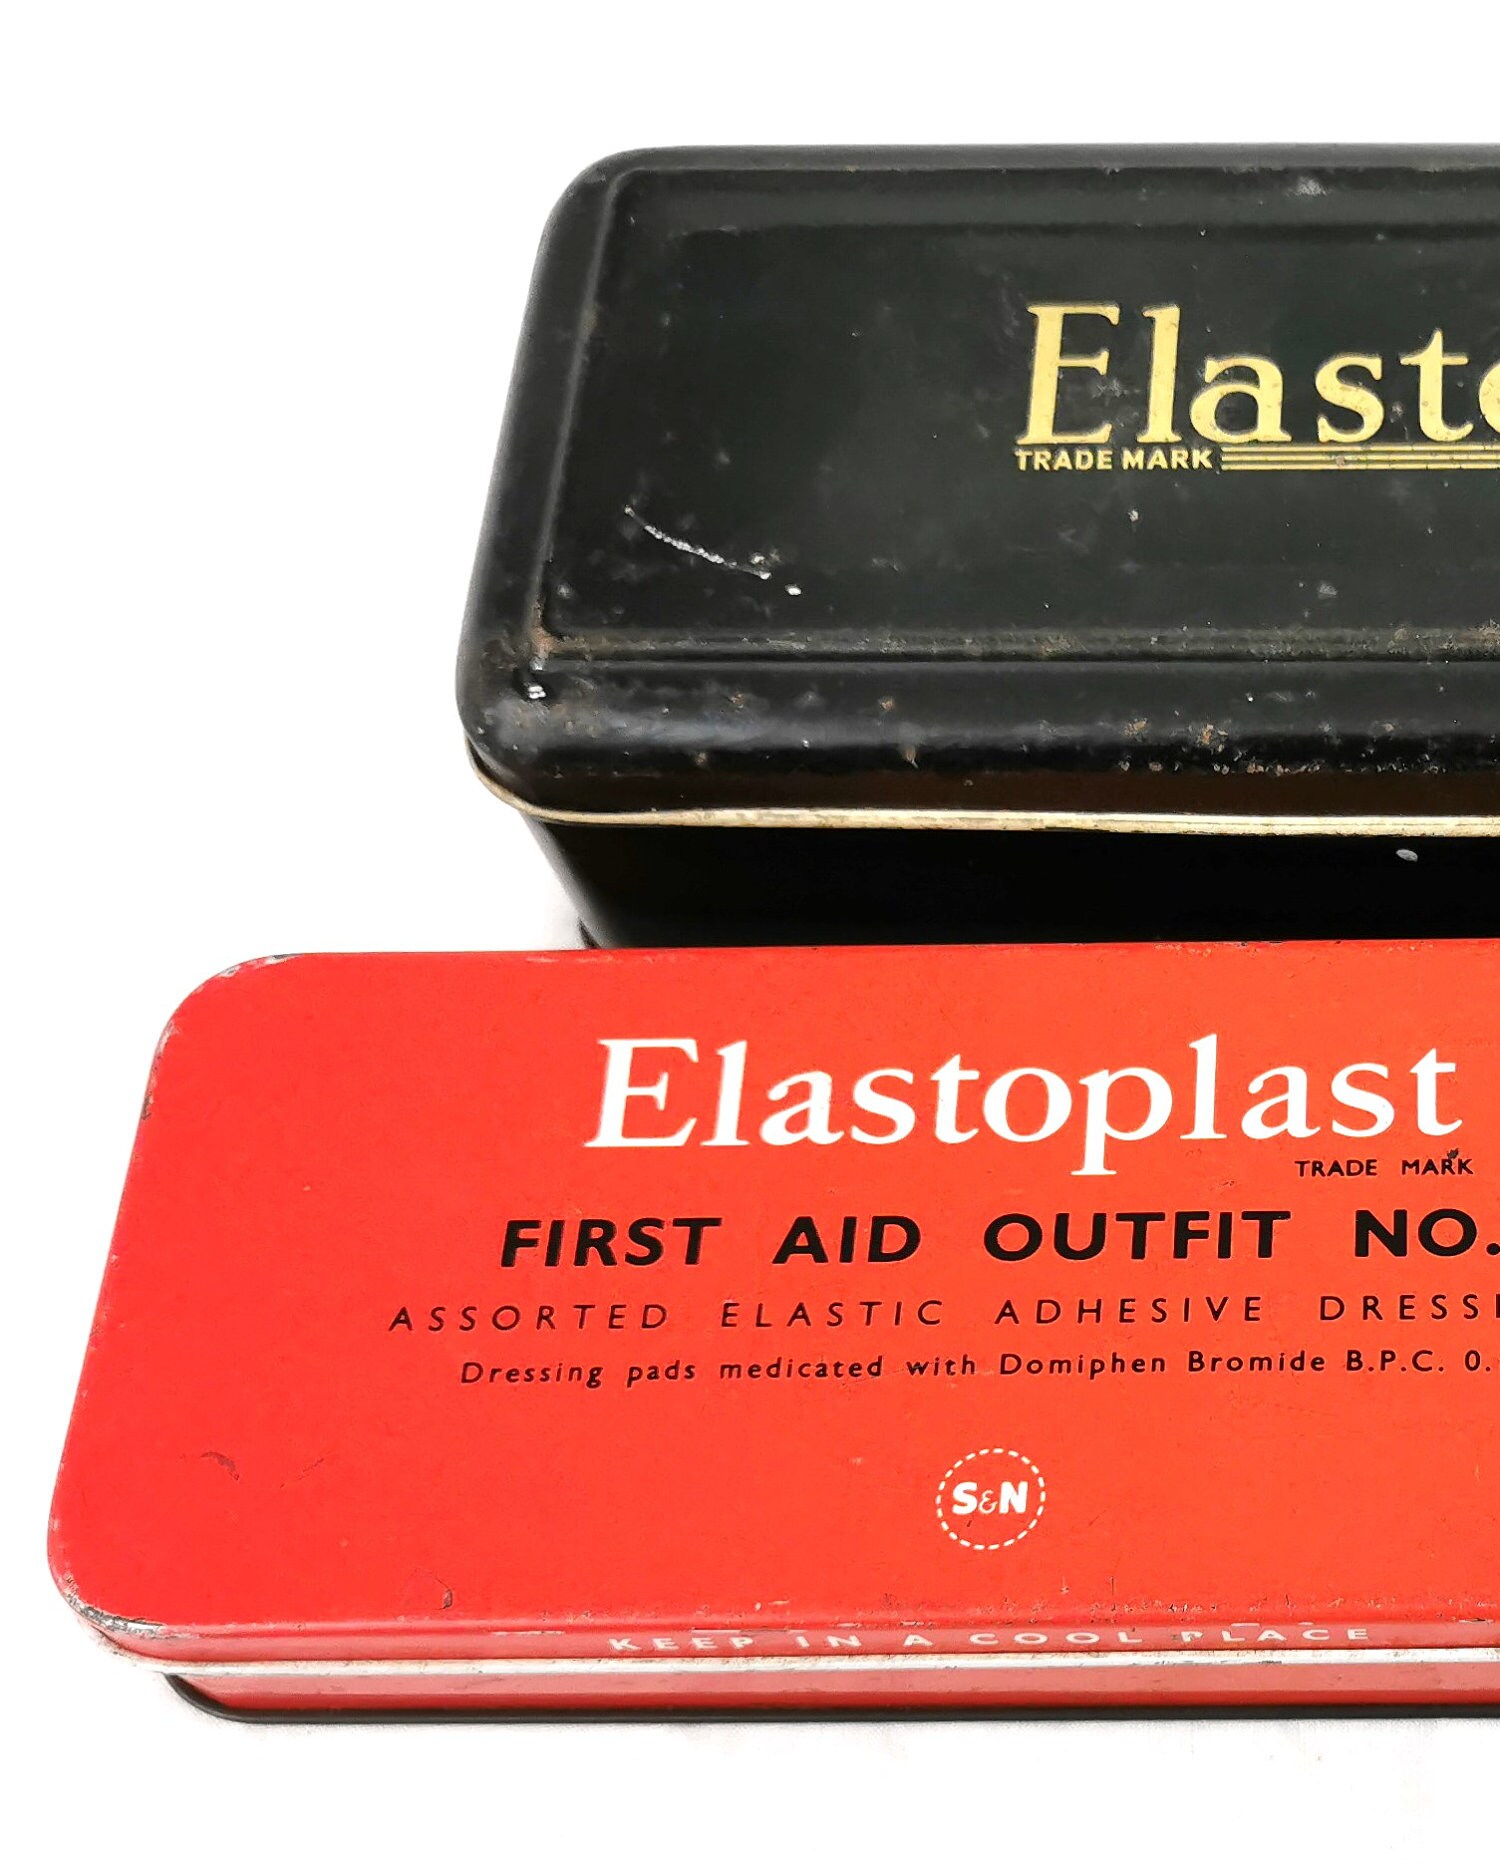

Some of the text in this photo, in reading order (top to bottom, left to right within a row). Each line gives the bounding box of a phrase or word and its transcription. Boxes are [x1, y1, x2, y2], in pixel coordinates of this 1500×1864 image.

[1013, 448, 1214, 471] TRADE MARK
[584, 1033, 1463, 1176] Elastoplast
[1295, 1156, 1475, 1177] TRADE MARK
[500, 1217, 723, 1267] FIRST
[772, 1215, 921, 1264] AID
[983, 1210, 1291, 1262] OUTFIT
[389, 1303, 669, 1332] ASSORTED
[720, 1300, 944, 1328] ELASTIC
[994, 1296, 1263, 1325] ADHESIVE
[460, 1360, 604, 1388] Dressing
[626, 1359, 697, 1388] pads
[719, 1355, 884, 1379] medicated
[905, 1353, 977, 1376] with
[999, 1352, 1167, 1381] Domiphen
[1188, 1349, 1326, 1373] Bromide
[1346, 1348, 1445, 1373] B.P.C.
[952, 1480, 1029, 1516] S&N
[608, 1628, 1369, 1651] KEEP IN A COOL PLACE
